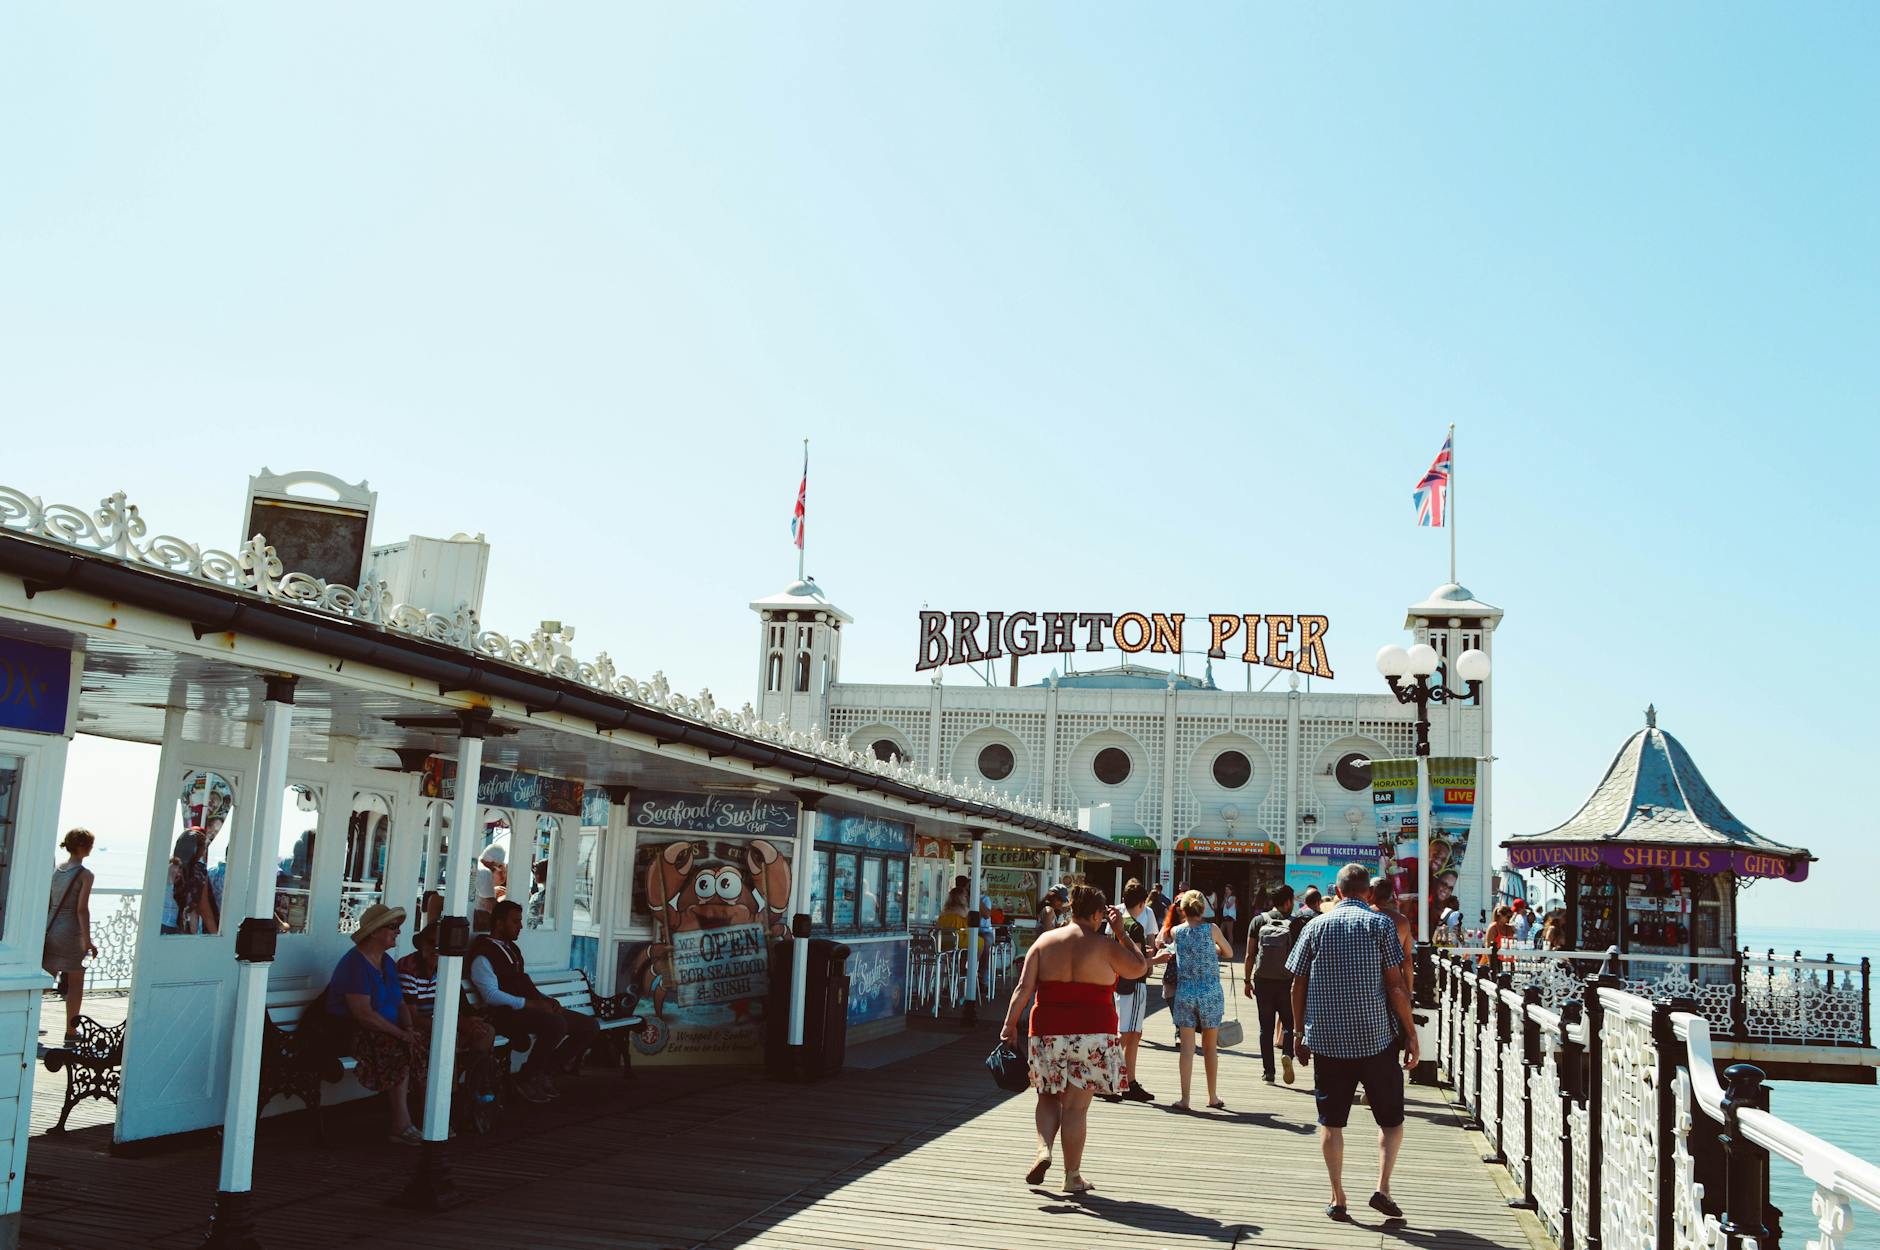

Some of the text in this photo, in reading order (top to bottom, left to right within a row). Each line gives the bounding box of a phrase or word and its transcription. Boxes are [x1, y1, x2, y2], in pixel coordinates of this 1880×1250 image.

[915, 610, 1334, 680] BRIGHTON PIER
[477, 771, 515, 802] eafood
[514, 775, 543, 803] Sushi
[1373, 779, 1415, 788] HORATIO'S
[1433, 777, 1475, 785] HORATIO'S
[1375, 793, 1391, 802] BAR
[1447, 791, 1473, 801] LIVE
[637, 795, 714, 827] Seafood
[716, 799, 767, 827] Sushi
[747, 822, 769, 833] Bar
[1134, 839, 1152, 847] FUN
[1310, 847, 1331, 855] WHERE
[1333, 847, 1357, 856] TICKETS
[1359, 848, 1376, 856] MAKE
[1512, 846, 1785, 876] SOUVENIRS SHELLS GIFTS
[678, 938, 695, 950] WE
[678, 927, 760, 965] ARE OPEN
[679, 959, 765, 985] FOR SEAFOOD
[712, 978, 750, 998] SUSHI
